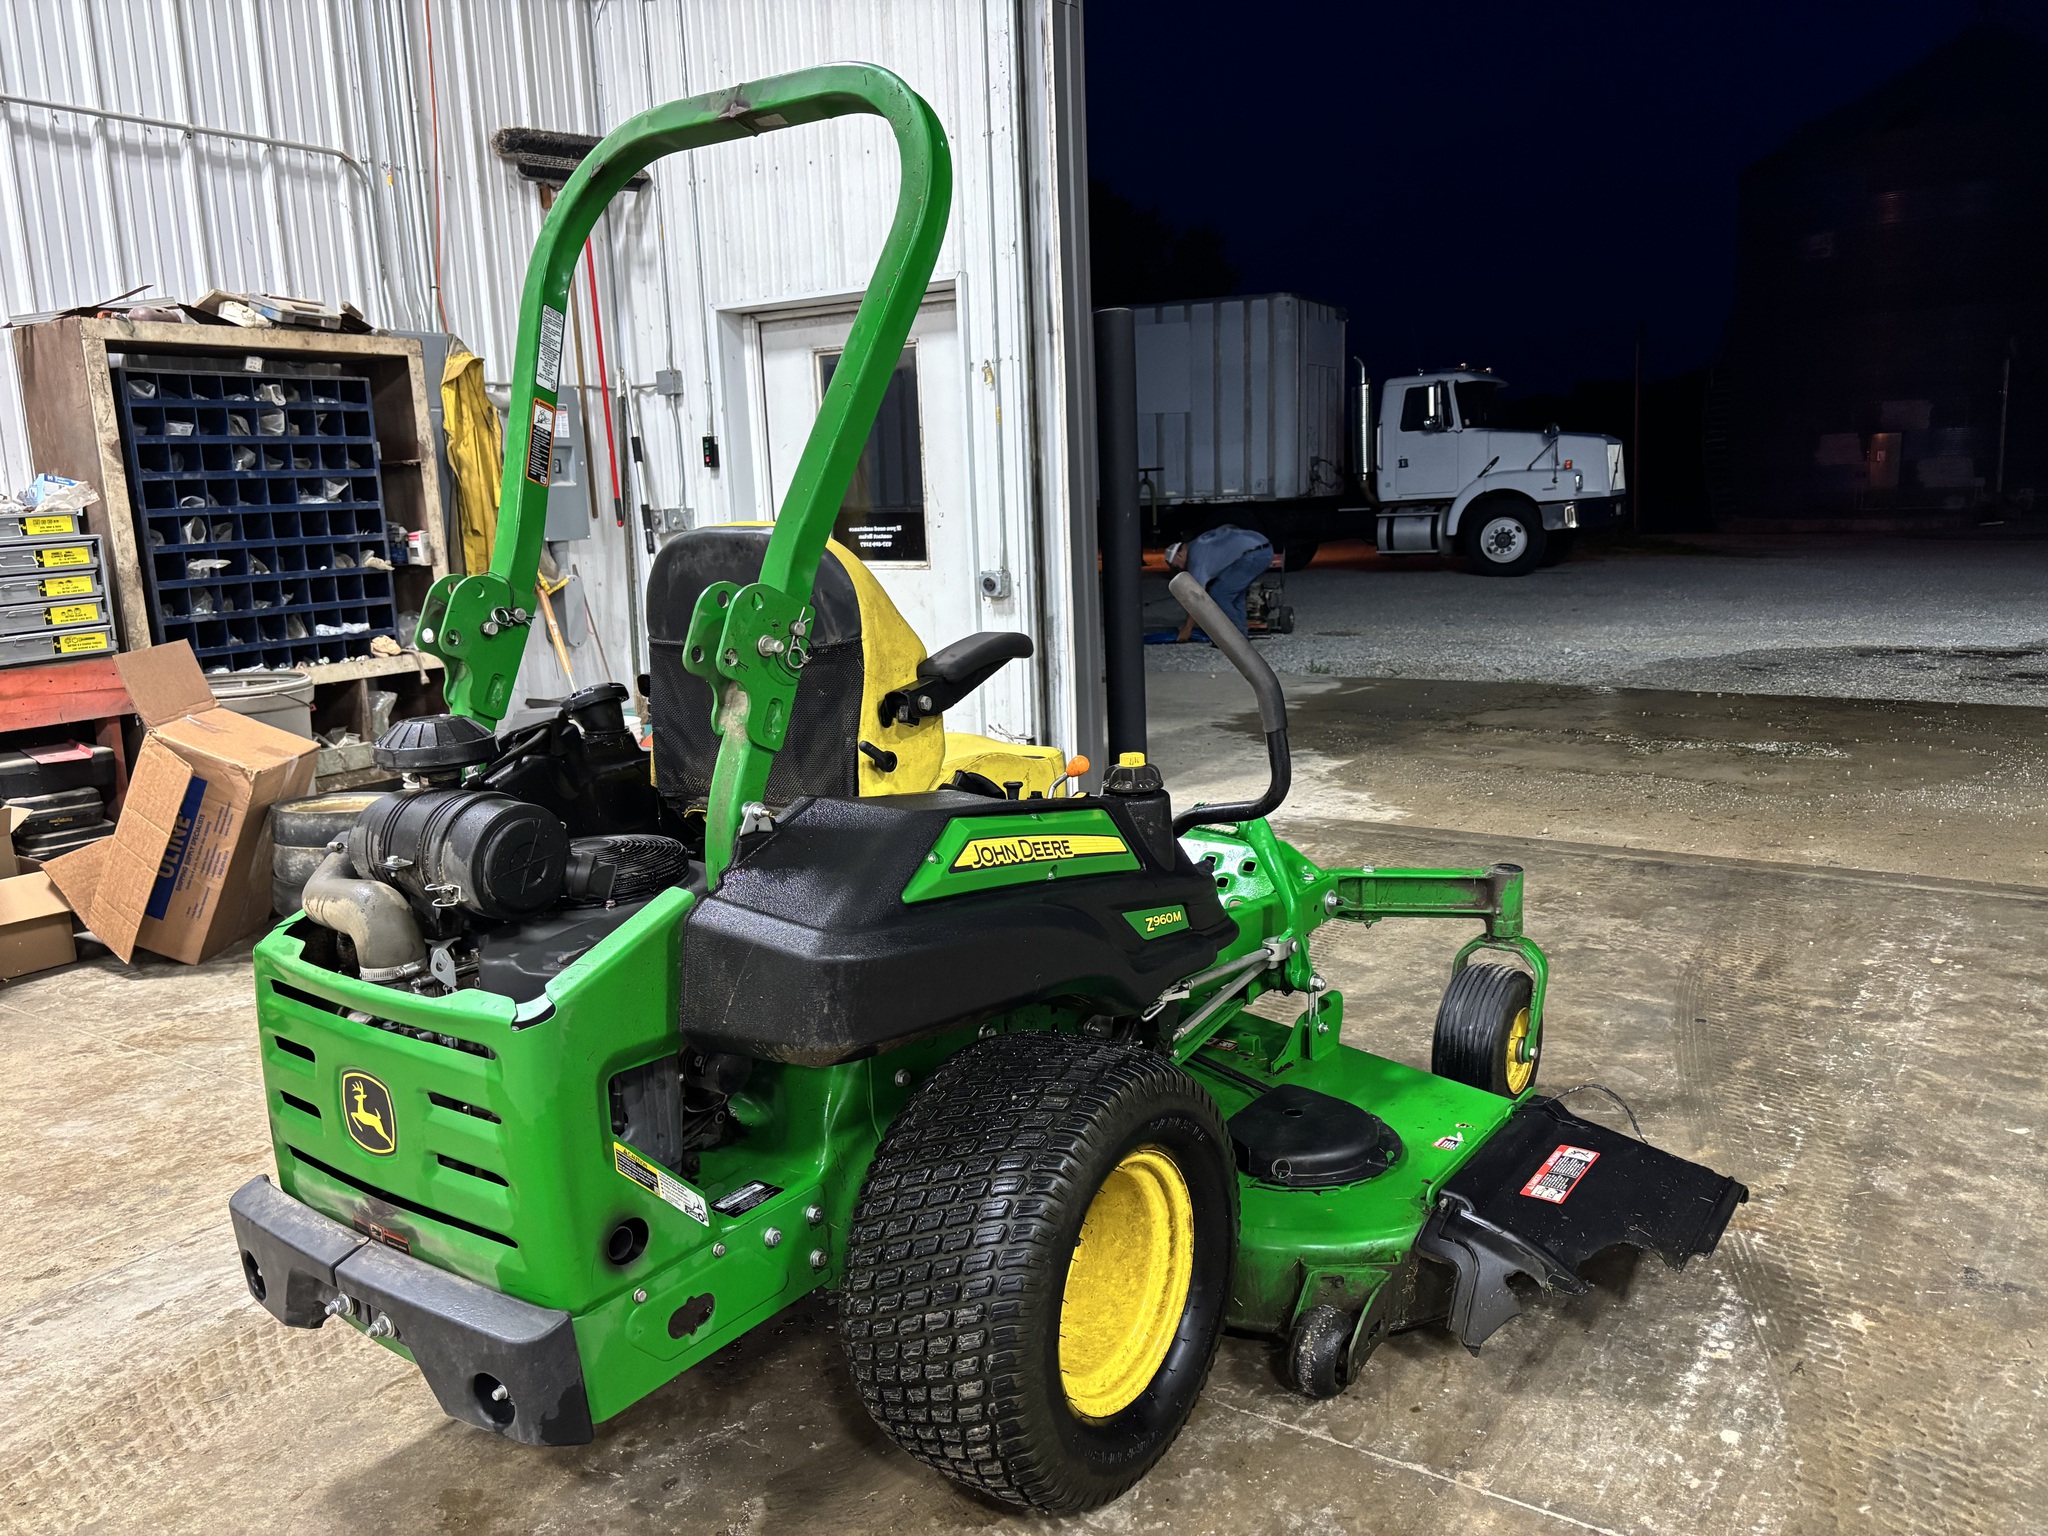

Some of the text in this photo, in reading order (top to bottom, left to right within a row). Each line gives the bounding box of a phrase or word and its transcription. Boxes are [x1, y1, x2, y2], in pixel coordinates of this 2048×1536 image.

[973, 839, 1073, 866] JOHN DEERE
[1145, 910, 1182, 932] Z960M
